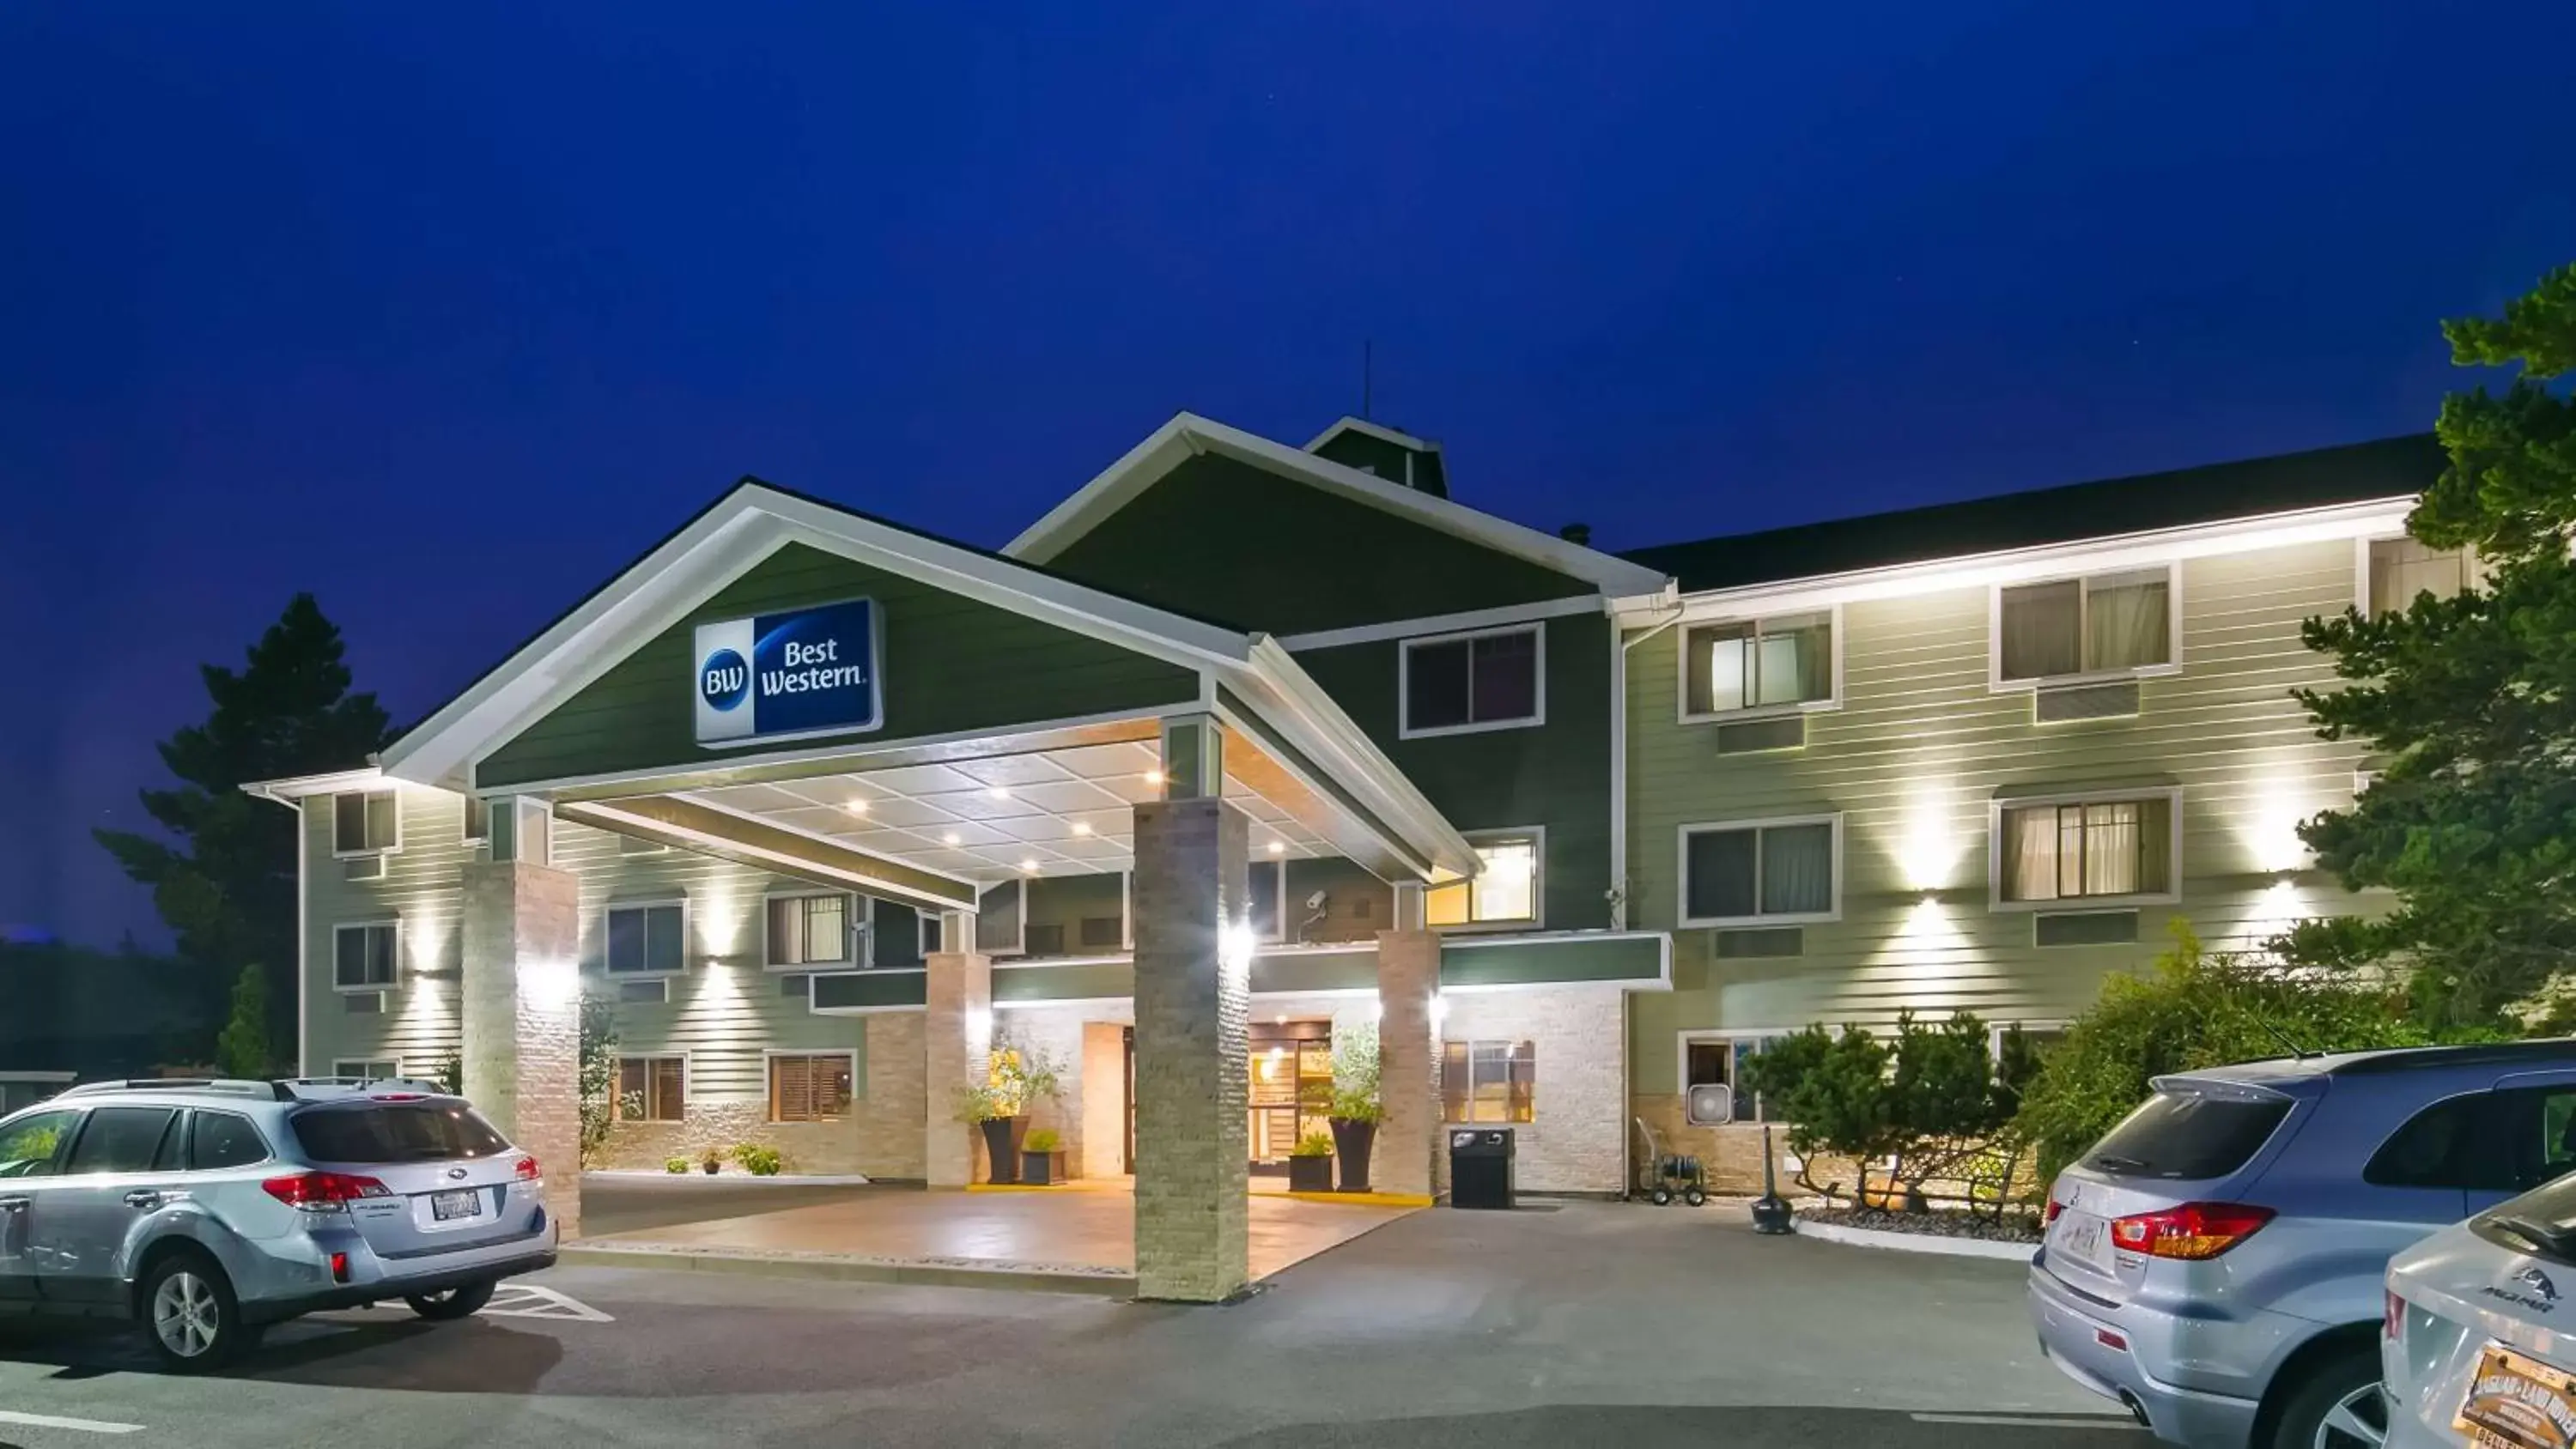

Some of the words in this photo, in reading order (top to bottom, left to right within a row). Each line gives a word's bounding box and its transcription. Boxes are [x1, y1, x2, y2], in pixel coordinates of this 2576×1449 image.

[785, 639, 838, 667] Best
[707, 666, 744, 695] BW
[762, 664, 861, 696] Western
